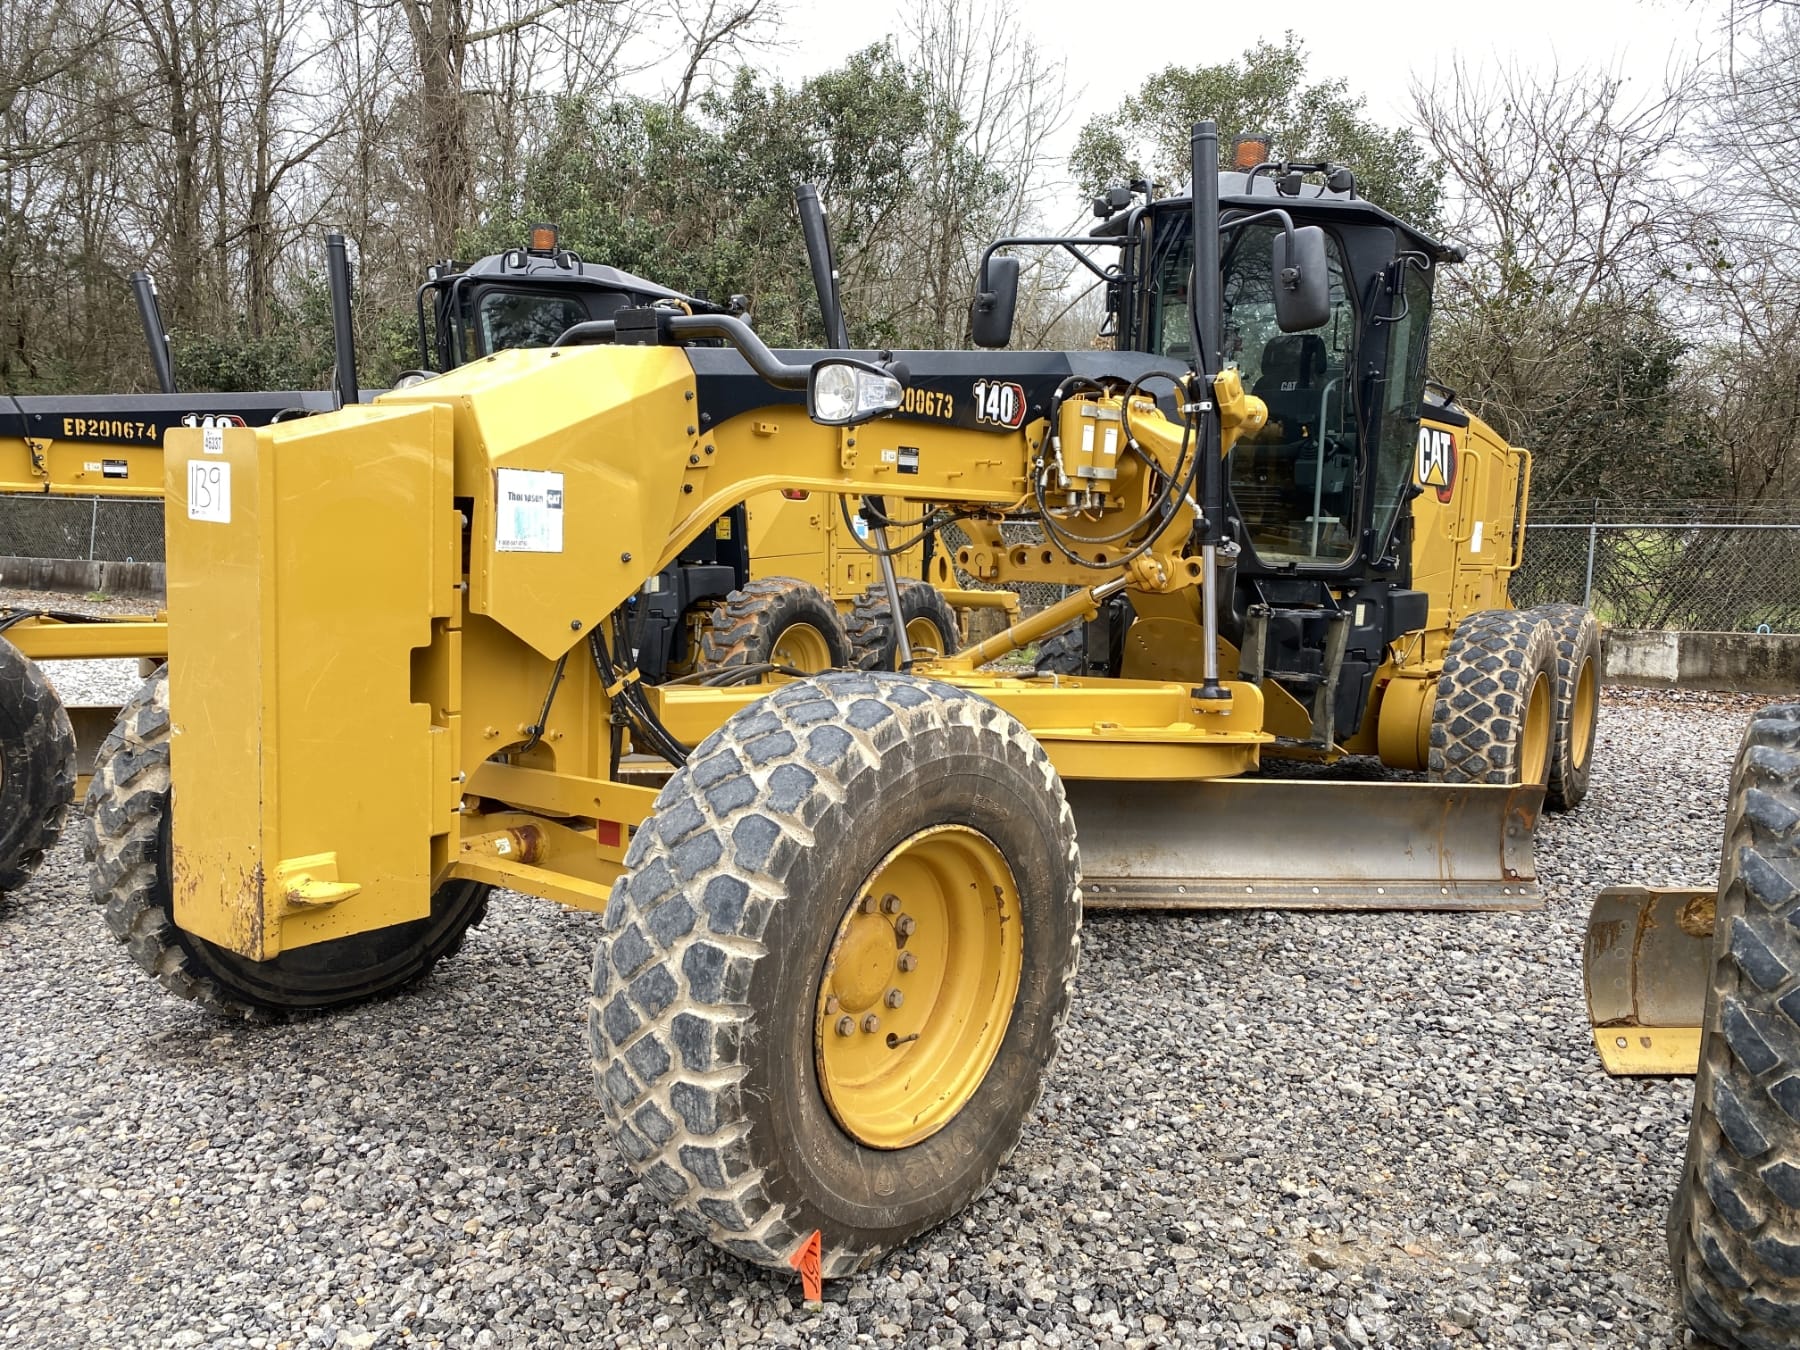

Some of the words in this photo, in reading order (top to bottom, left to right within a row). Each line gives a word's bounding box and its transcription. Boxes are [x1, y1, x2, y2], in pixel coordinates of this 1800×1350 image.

[1280, 381, 1298, 391] CAT
[975, 382, 1014, 423] 140
[63, 417, 157, 441] EB200674
[1418, 427, 1451, 487] CAT
